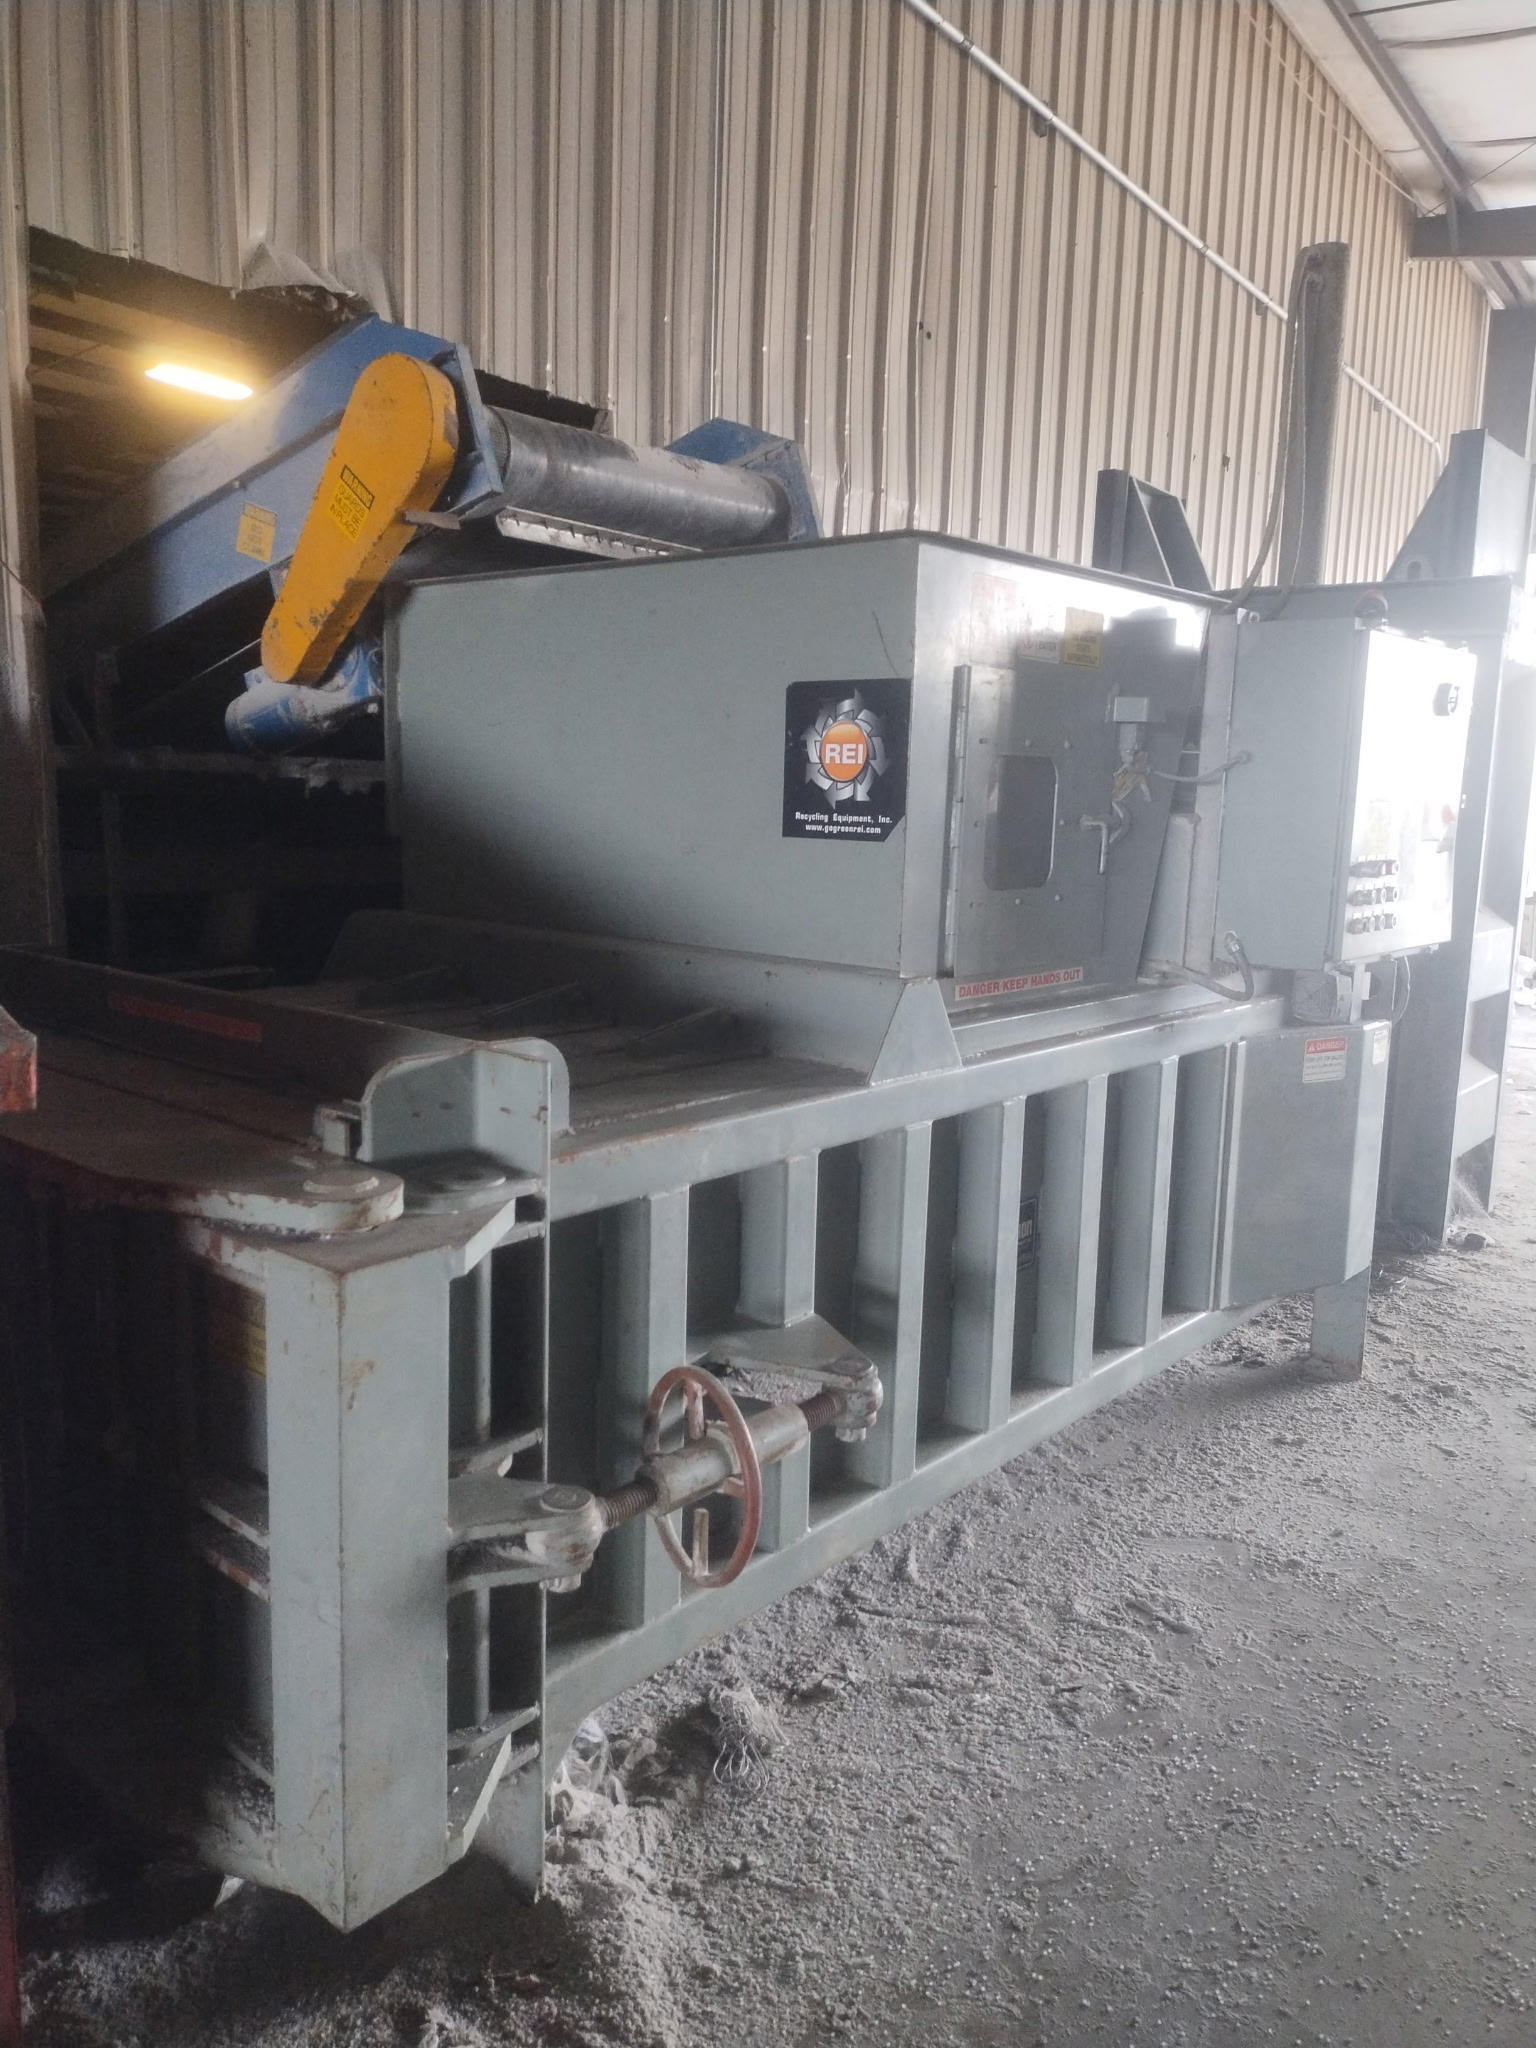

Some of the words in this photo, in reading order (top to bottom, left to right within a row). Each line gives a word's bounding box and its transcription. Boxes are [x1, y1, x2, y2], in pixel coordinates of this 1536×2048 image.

[339, 484, 365, 518] GUARDS
[342, 467, 373, 507] WARNING
[335, 493, 353, 517] MUST
[351, 513, 362, 528] BE
[336, 511, 358, 539] PLACE
[825, 743, 864, 765] REI
[795, 811, 829, 823] Recycling
[832, 812, 874, 824] Equipment,
[878, 815, 893, 824] Inc.
[805, 823, 881, 834] www.gogreenrei.com
[958, 982, 1000, 998] DANGER
[1002, 978, 1028, 991] KEEP
[1030, 972, 1061, 987] HANDS
[1062, 968, 1081, 981] OUT
[1316, 1040, 1345, 1051] DANGER
